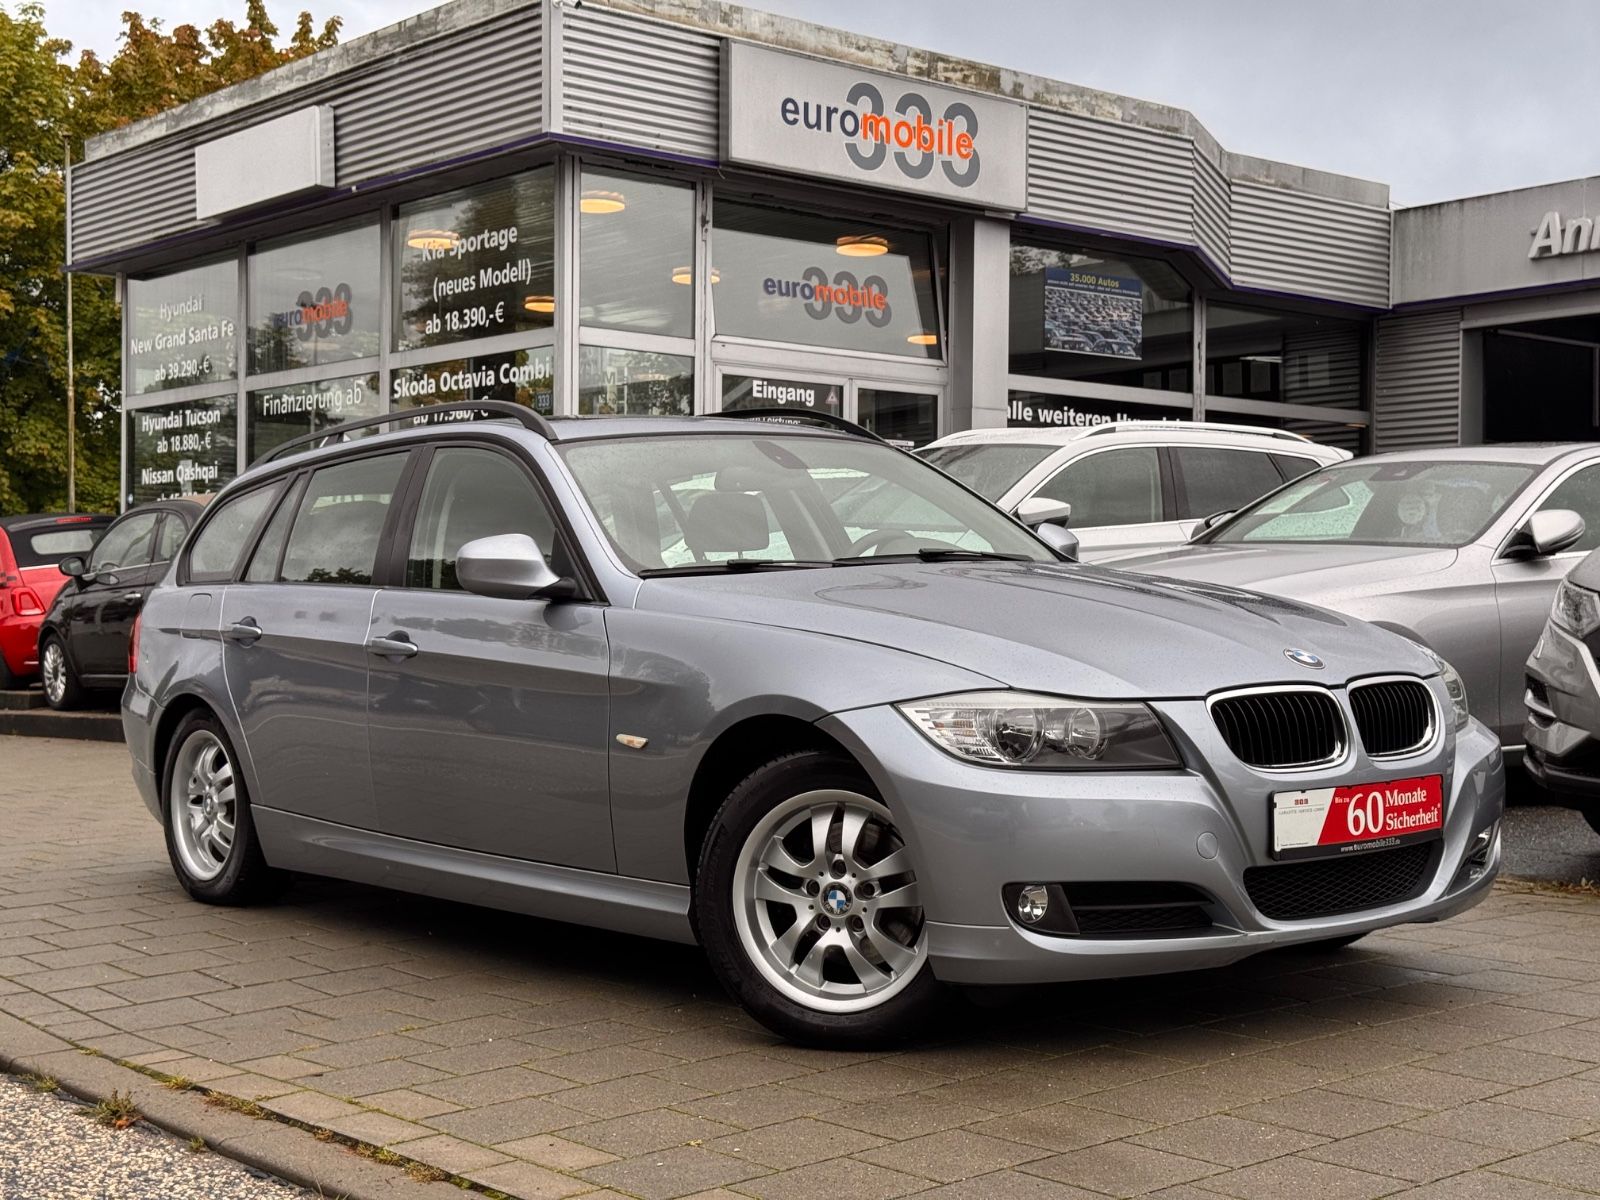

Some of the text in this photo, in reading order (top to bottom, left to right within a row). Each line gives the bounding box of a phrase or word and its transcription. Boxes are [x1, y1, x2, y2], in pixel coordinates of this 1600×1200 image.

[781, 97, 974, 159] euromobile
[845, 82, 980, 188] 333
[422, 226, 518, 262] Kia Sportage
[433, 258, 532, 302] (neues Modell)
[763, 277, 887, 310] euromobile
[802, 266, 892, 328] 333
[1070, 273, 1097, 285] 35.000
[1098, 276, 1120, 288] Autos
[160, 294, 203, 322] Hyundai
[296, 283, 354, 342] 333
[425, 313, 441, 335] ab
[131, 320, 234, 356] New Grand Santa Fe
[155, 363, 166, 381] ab
[393, 356, 550, 399] Skoda Octavia Combi
[263, 380, 362, 416] Finanzierung ab
[752, 379, 815, 407] Eingang
[142, 409, 220, 436] Hyundai Tucson
[1037, 406, 1112, 428] weiteren
[157, 437, 168, 453] ab
[142, 461, 218, 485] Nissan Qashqai
[1347, 791, 1384, 836] 60
[1385, 787, 1427, 807] Monate
